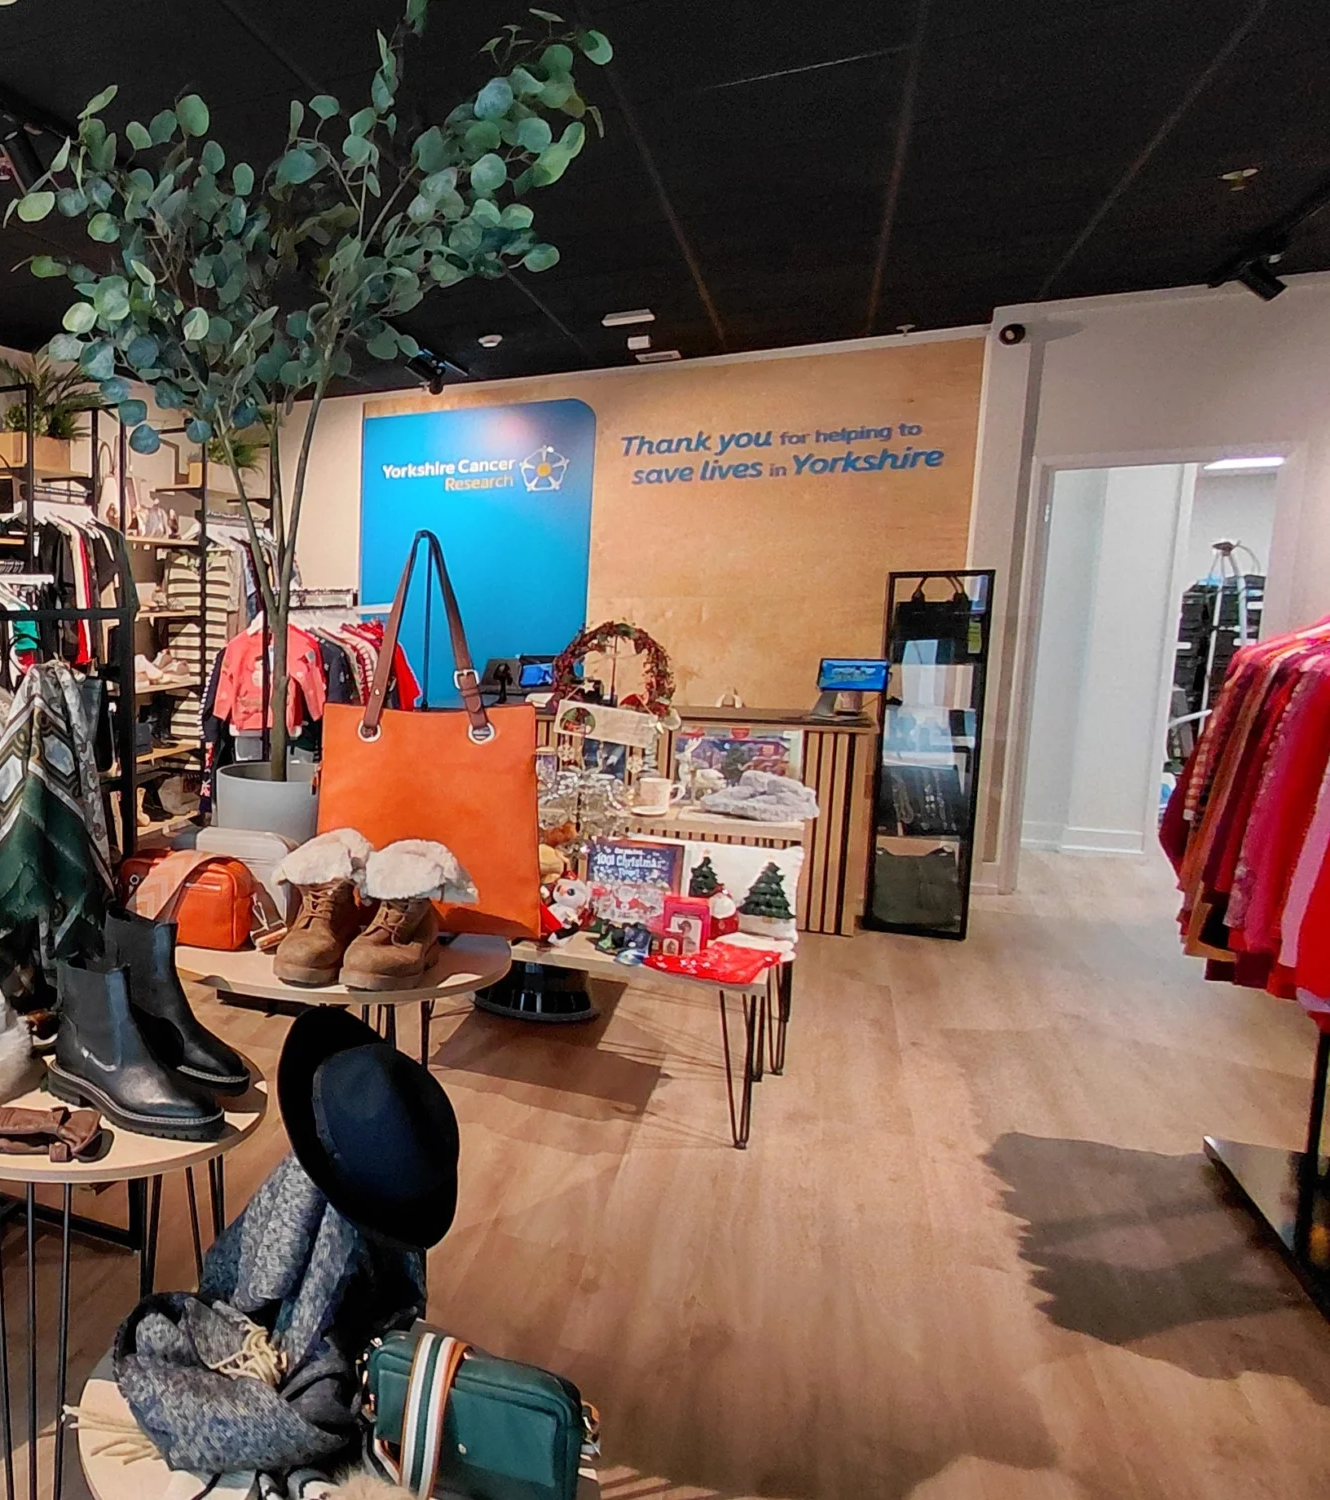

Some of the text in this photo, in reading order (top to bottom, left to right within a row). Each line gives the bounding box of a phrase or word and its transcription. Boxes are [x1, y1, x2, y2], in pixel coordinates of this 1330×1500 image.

[621, 423, 923, 457] Thank you for helping to
[382, 458, 516, 479] Yorkshire Cancer
[631, 446, 945, 485] save lives in Yorkshire
[445, 474, 514, 492] Research
